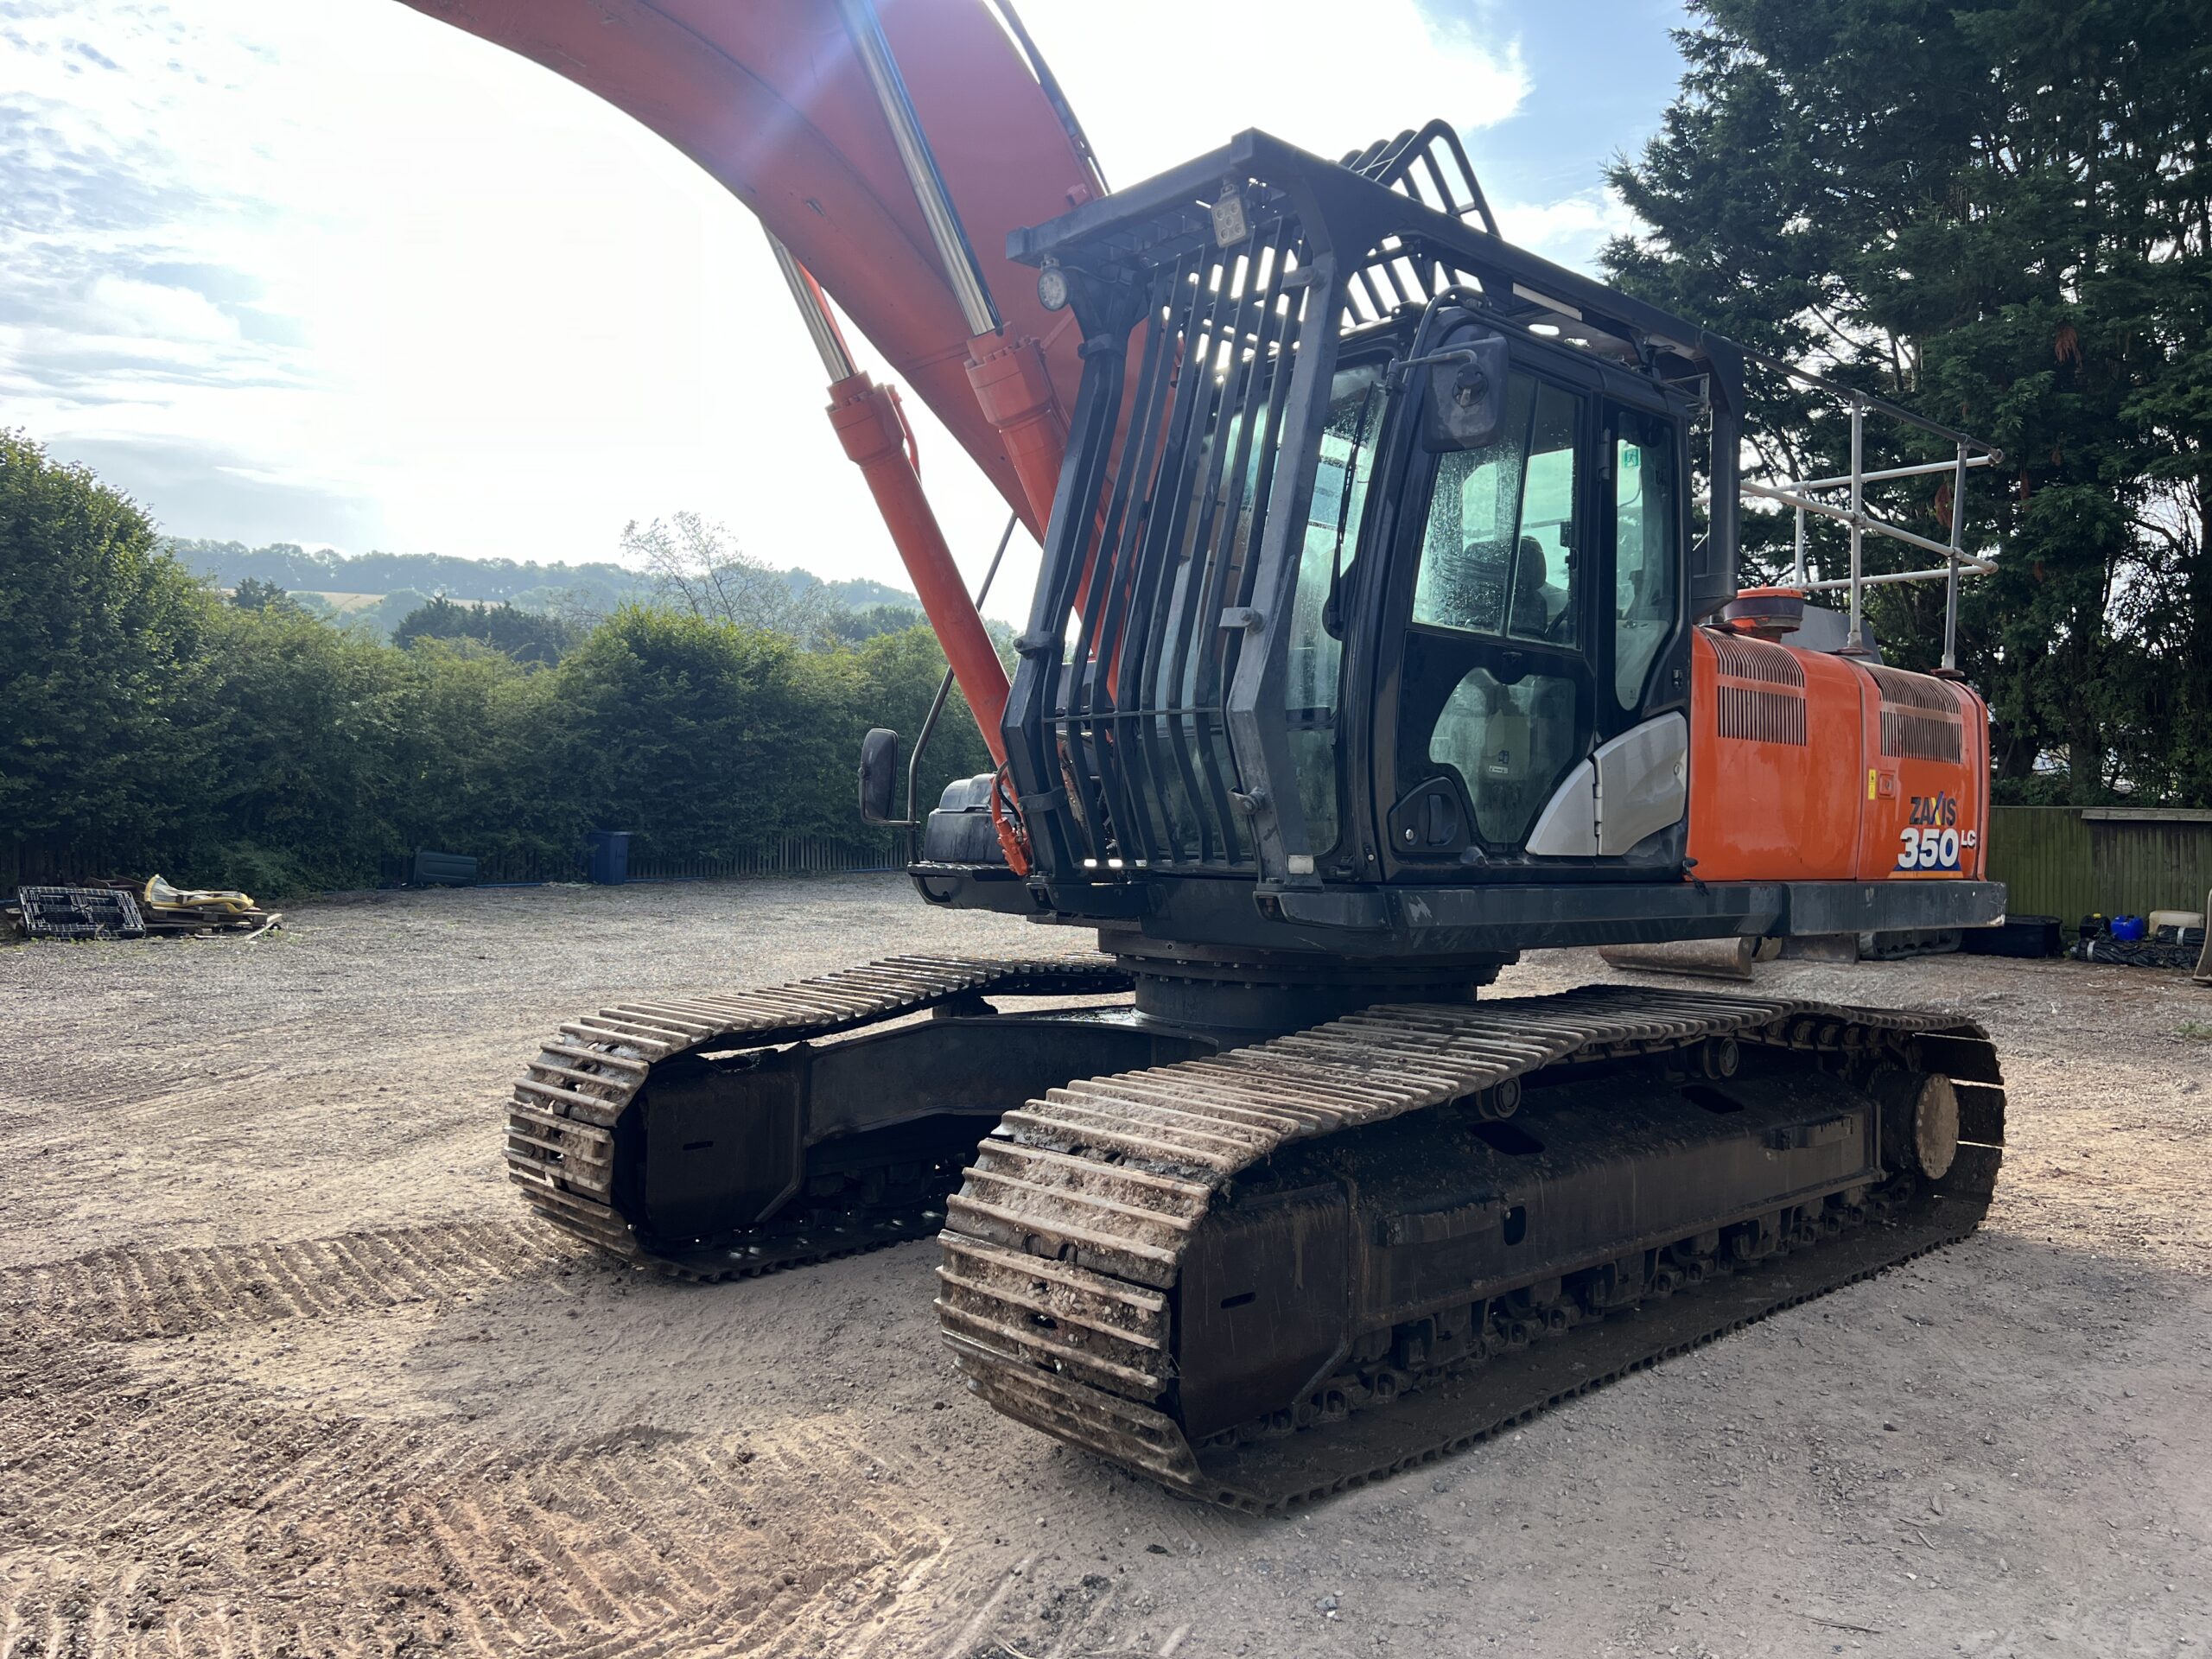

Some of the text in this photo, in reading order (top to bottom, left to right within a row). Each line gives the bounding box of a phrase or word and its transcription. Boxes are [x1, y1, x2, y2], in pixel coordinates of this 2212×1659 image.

[1910, 791, 1956, 825] ZAXIS
[1897, 827, 1976, 868] 350 LC
